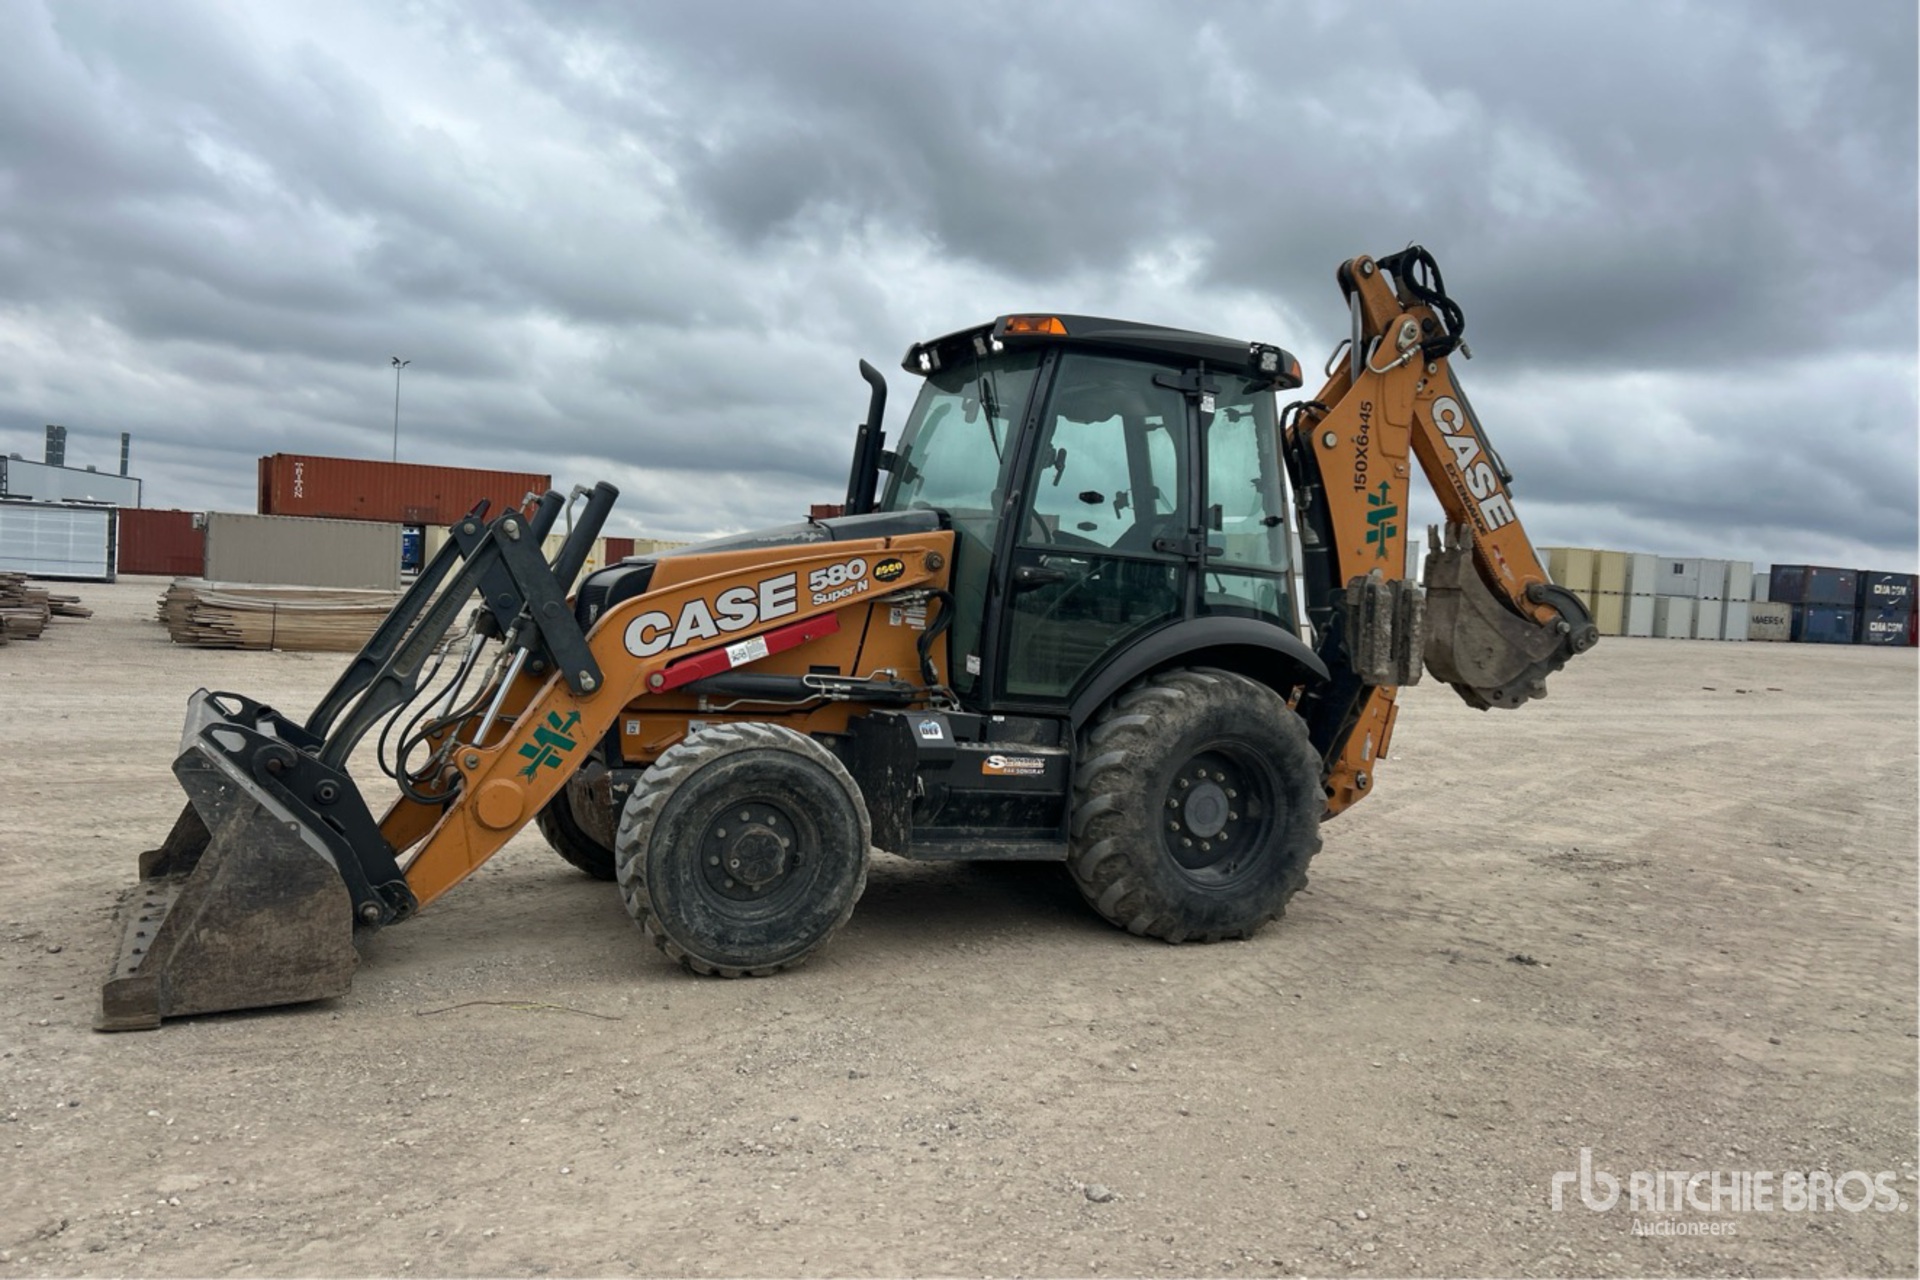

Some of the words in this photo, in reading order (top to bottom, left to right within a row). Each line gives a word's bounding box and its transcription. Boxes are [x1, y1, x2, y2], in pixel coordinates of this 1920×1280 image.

[1354, 401, 1373, 493] 150X6445
[1431, 395, 1515, 532] CASE
[808, 557, 868, 592] 580
[812, 585, 857, 606] Super
[856, 578, 869, 594] N
[623, 572, 798, 658] CASE
[1752, 614, 1784, 626] MAERSK
[922, 726, 939, 735] DEF
